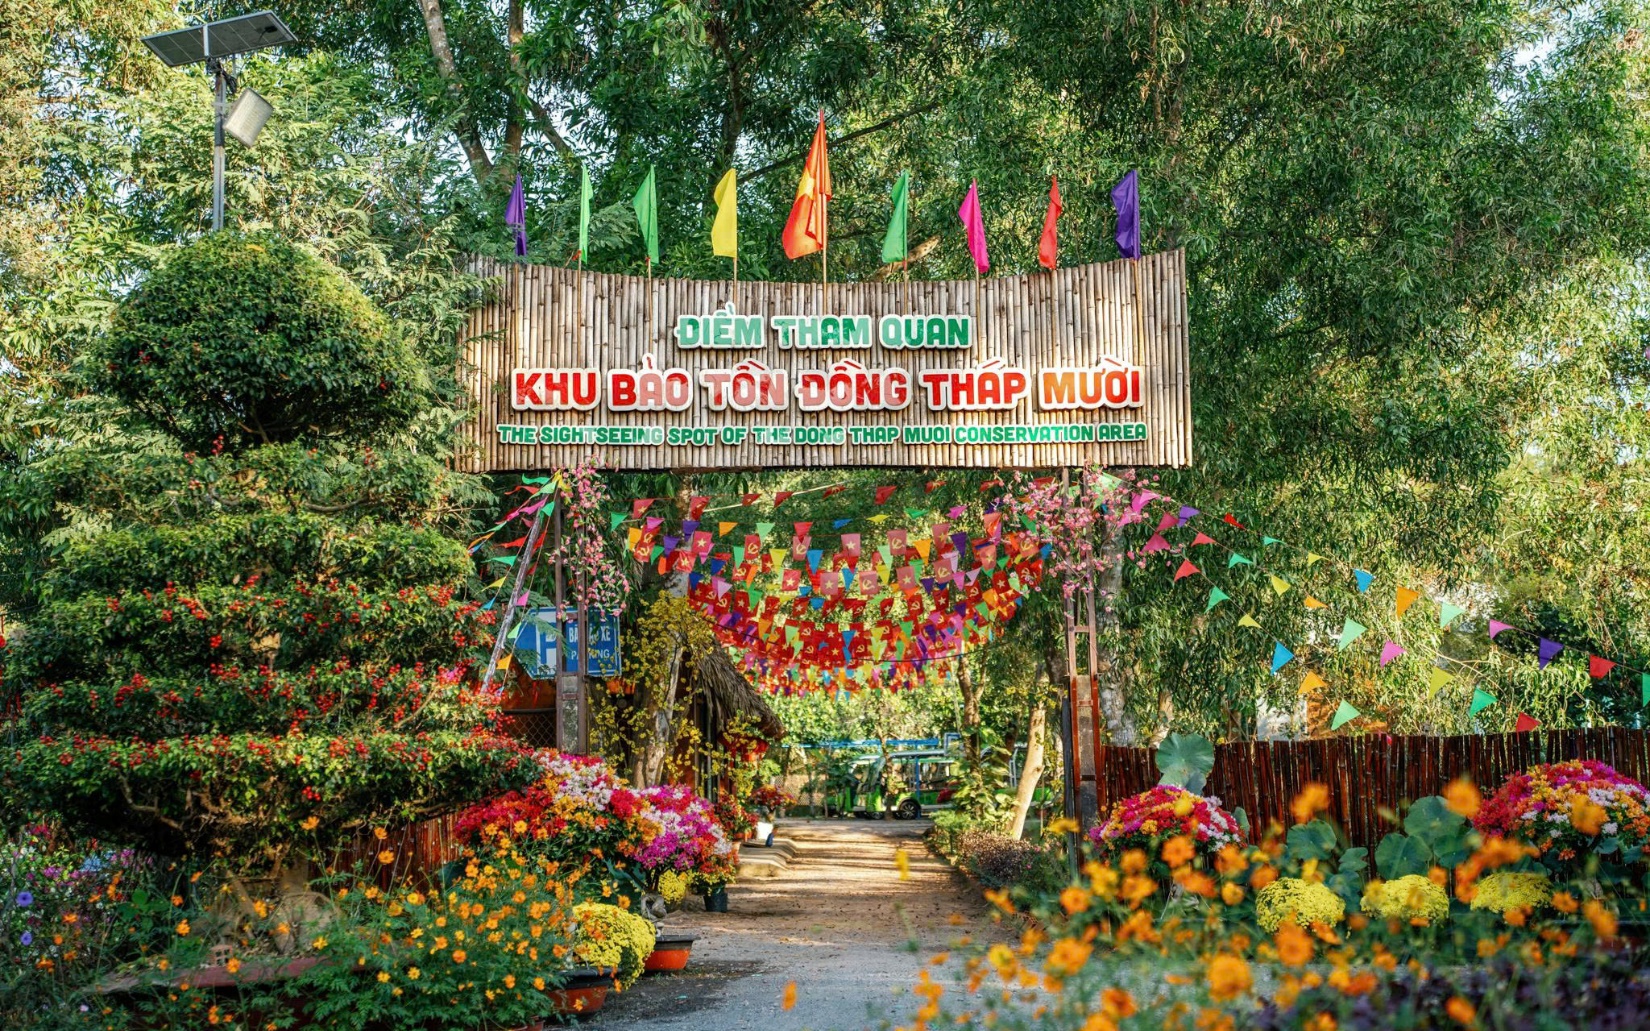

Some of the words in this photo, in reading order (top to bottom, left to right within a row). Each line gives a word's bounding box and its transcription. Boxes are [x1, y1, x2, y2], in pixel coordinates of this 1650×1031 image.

[676, 302, 762, 346] ĐIỂM
[773, 317, 869, 347] THAM
[882, 317, 970, 347] QUAN
[515, 371, 597, 406] KHU
[611, 356, 689, 407] BẢO
[703, 360, 785, 407] TỒN
[797, 360, 908, 407] ĐỒNG
[922, 360, 1027, 407] THÁP
[1042, 357, 1141, 405] MƯỜI
[498, 425, 536, 444] THE
[540, 426, 663, 445] SIGHTSEEING
[667, 427, 718, 445] SPOT
[721, 426, 747, 443] OF
[752, 426, 791, 443] THE
[794, 427, 844, 444] DONG
[849, 426, 900, 443] THAP
[904, 426, 951, 443] MUOI
[954, 424, 1094, 443] CONSERVATION
[1098, 423, 1147, 441] AREA
[600, 625, 611, 641] XE
